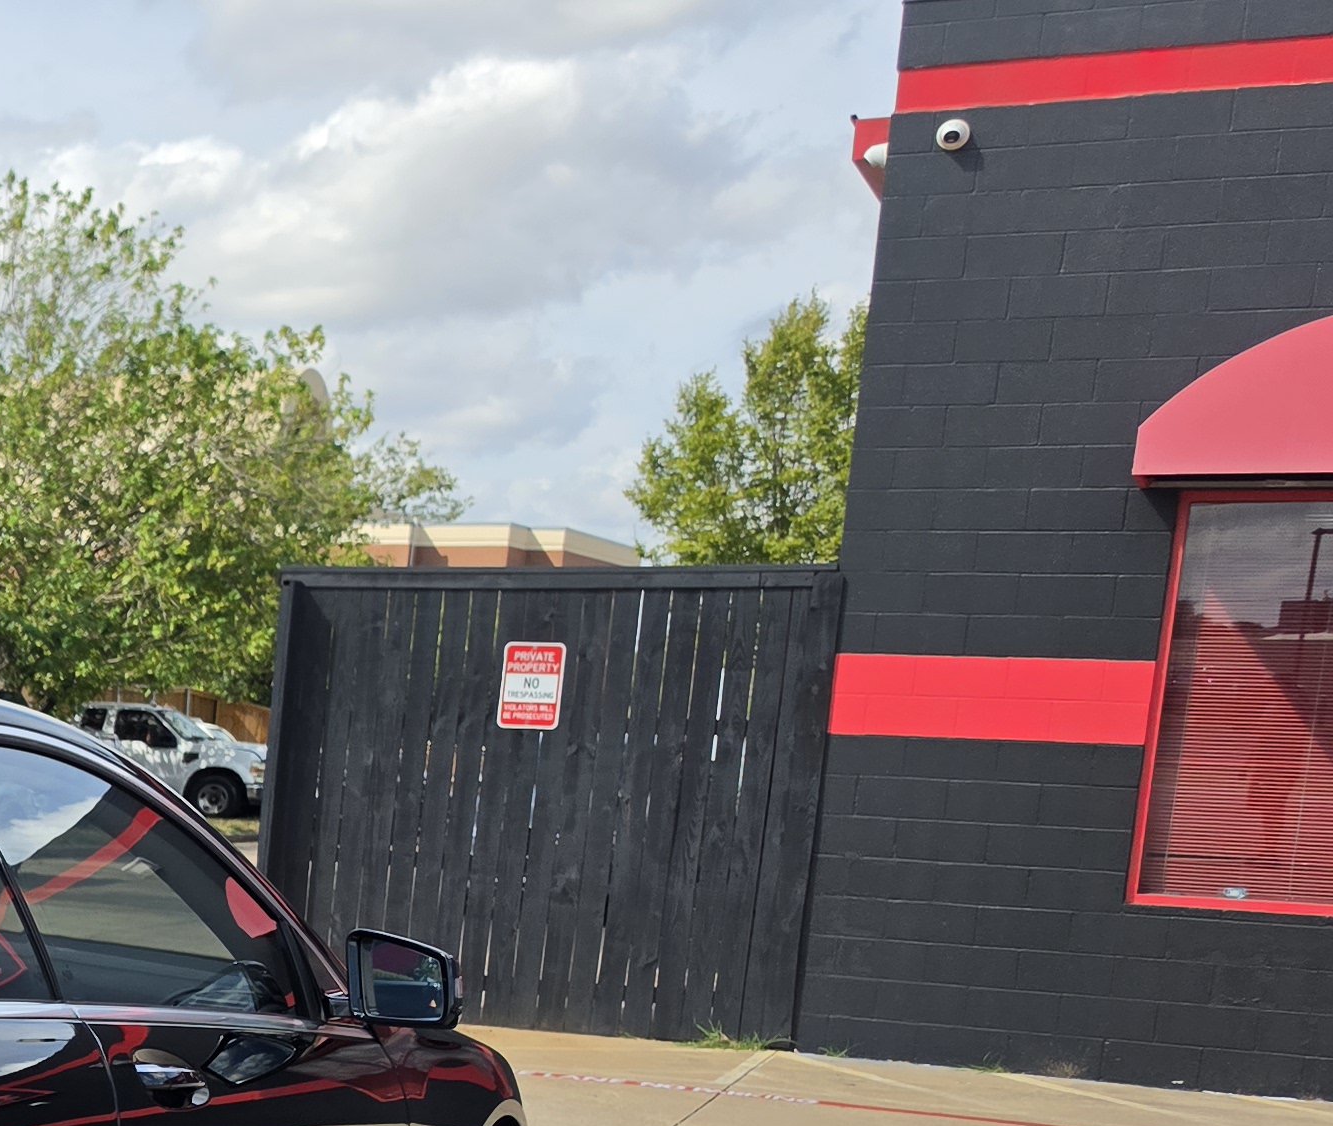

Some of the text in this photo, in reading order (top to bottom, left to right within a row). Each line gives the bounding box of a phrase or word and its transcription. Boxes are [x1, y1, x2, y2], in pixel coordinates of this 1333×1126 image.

[514, 651, 555, 662] PRIVATE
[507, 662, 559, 673] PROPERTY
[523, 677, 540, 689] NO
[508, 690, 553, 700] TRESPASSING
[504, 703, 538, 712] VIOLATORS
